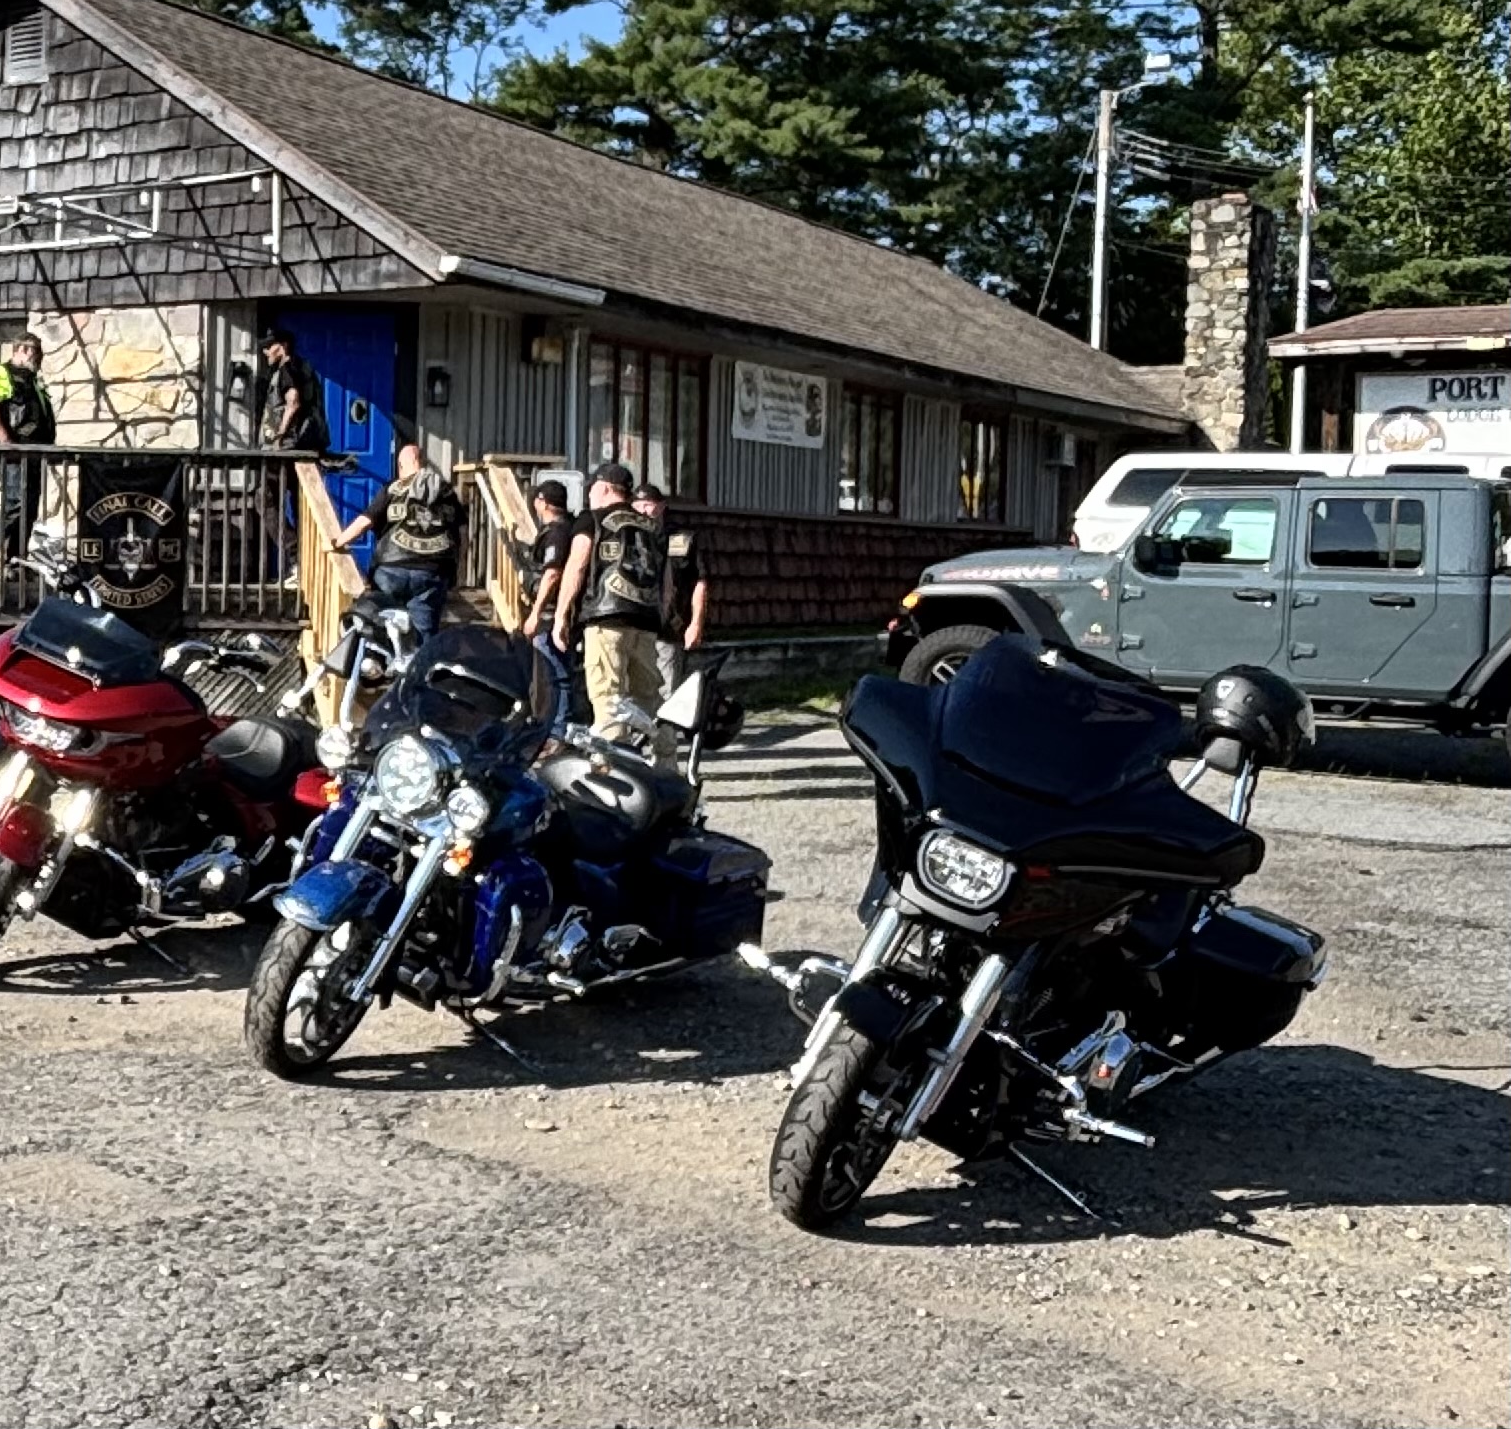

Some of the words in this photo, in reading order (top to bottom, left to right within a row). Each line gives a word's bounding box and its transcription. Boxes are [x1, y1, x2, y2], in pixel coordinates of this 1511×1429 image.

[1428, 376, 1505, 402] PORT
[91, 496, 128, 519] FINAL
[134, 496, 167, 518] CALL
[84, 542, 100, 557] LE
[163, 542, 179, 558] MC
